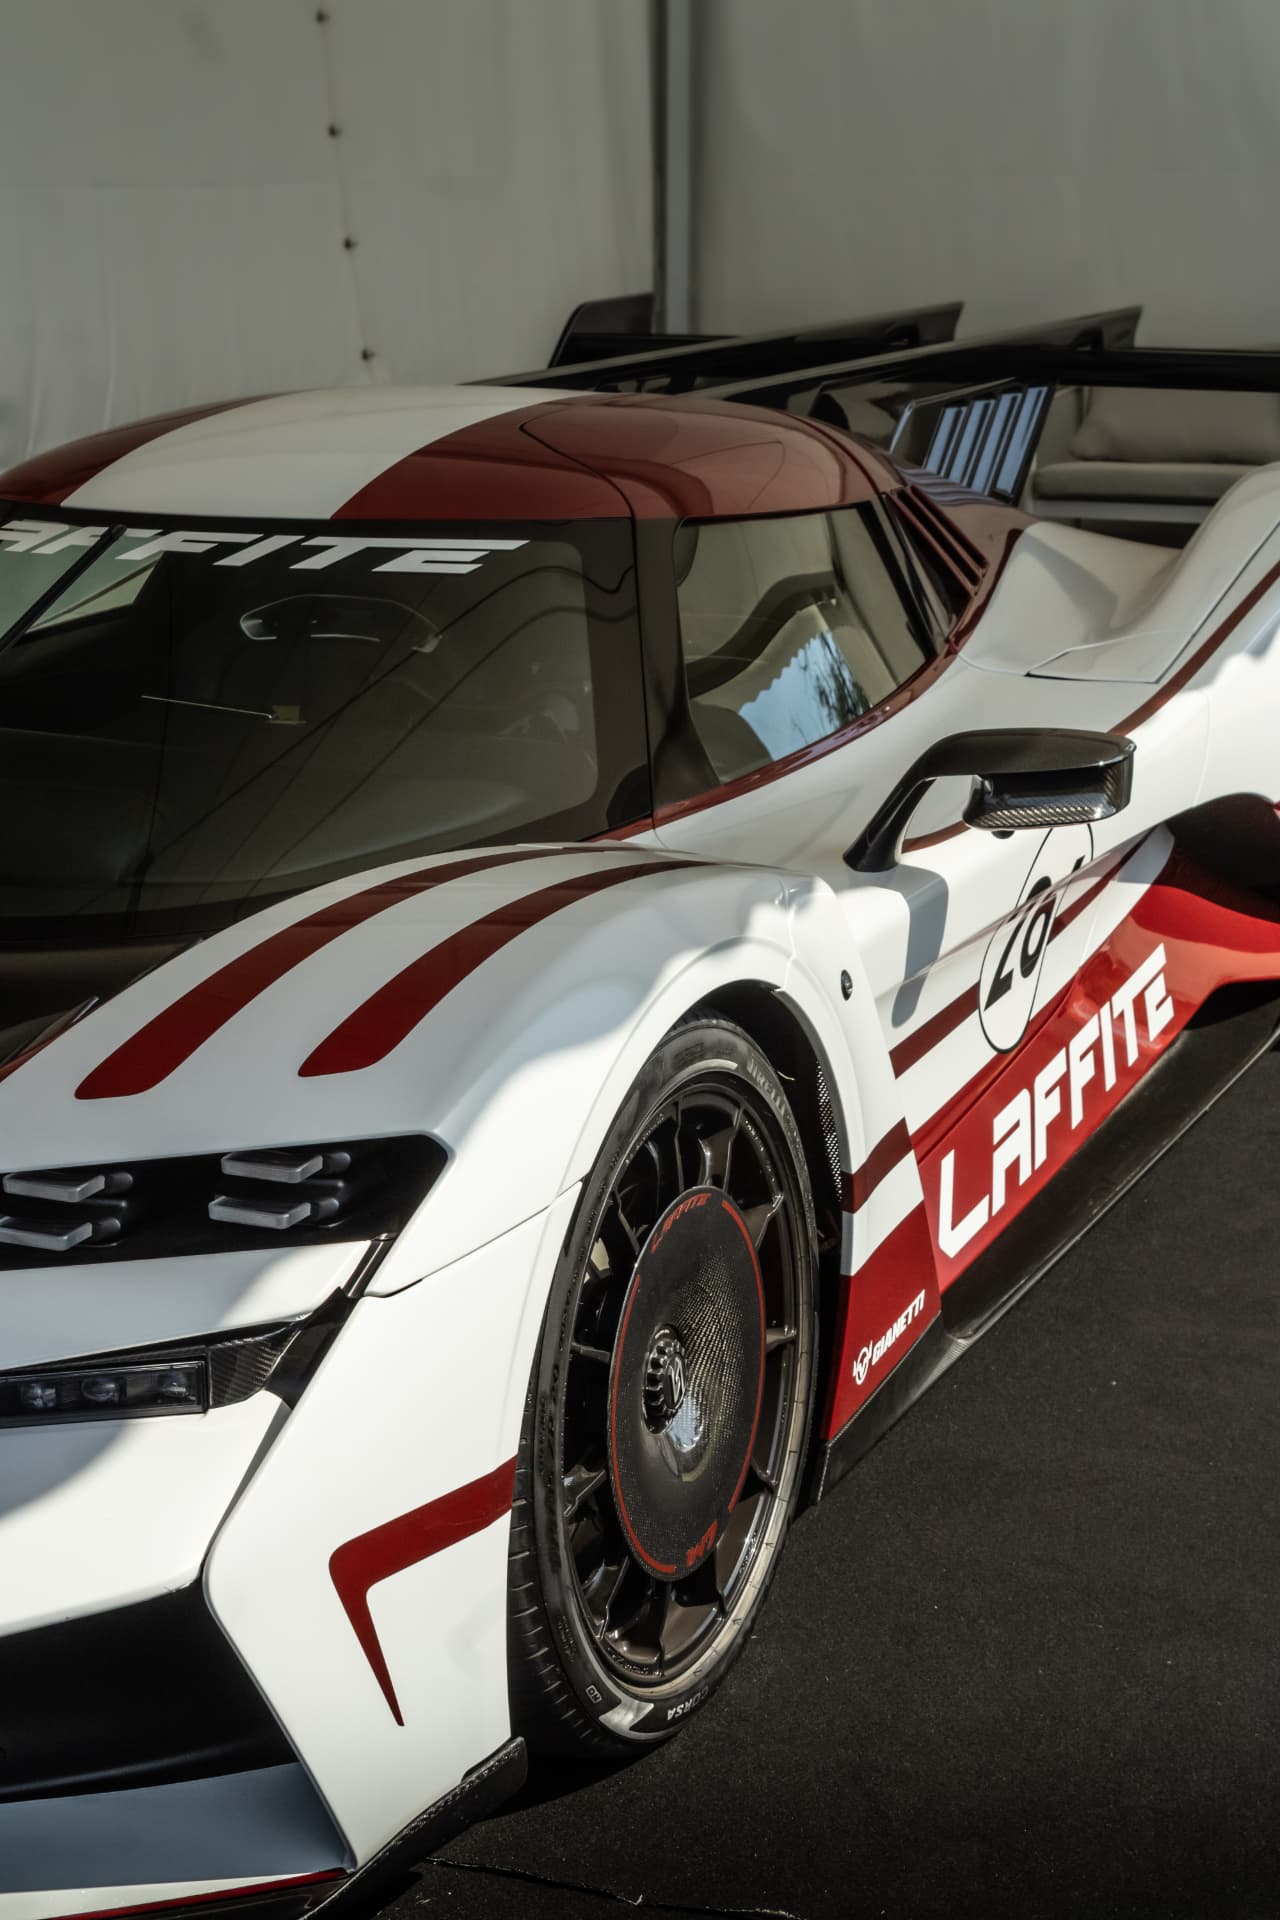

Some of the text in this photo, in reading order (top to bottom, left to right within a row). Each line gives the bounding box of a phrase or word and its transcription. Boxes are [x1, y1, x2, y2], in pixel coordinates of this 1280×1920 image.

[938, 942, 1175, 1259] LAFFITE
[871, 1288, 926, 1367] GIANETTI
[666, 1685, 709, 1721] CORSA
